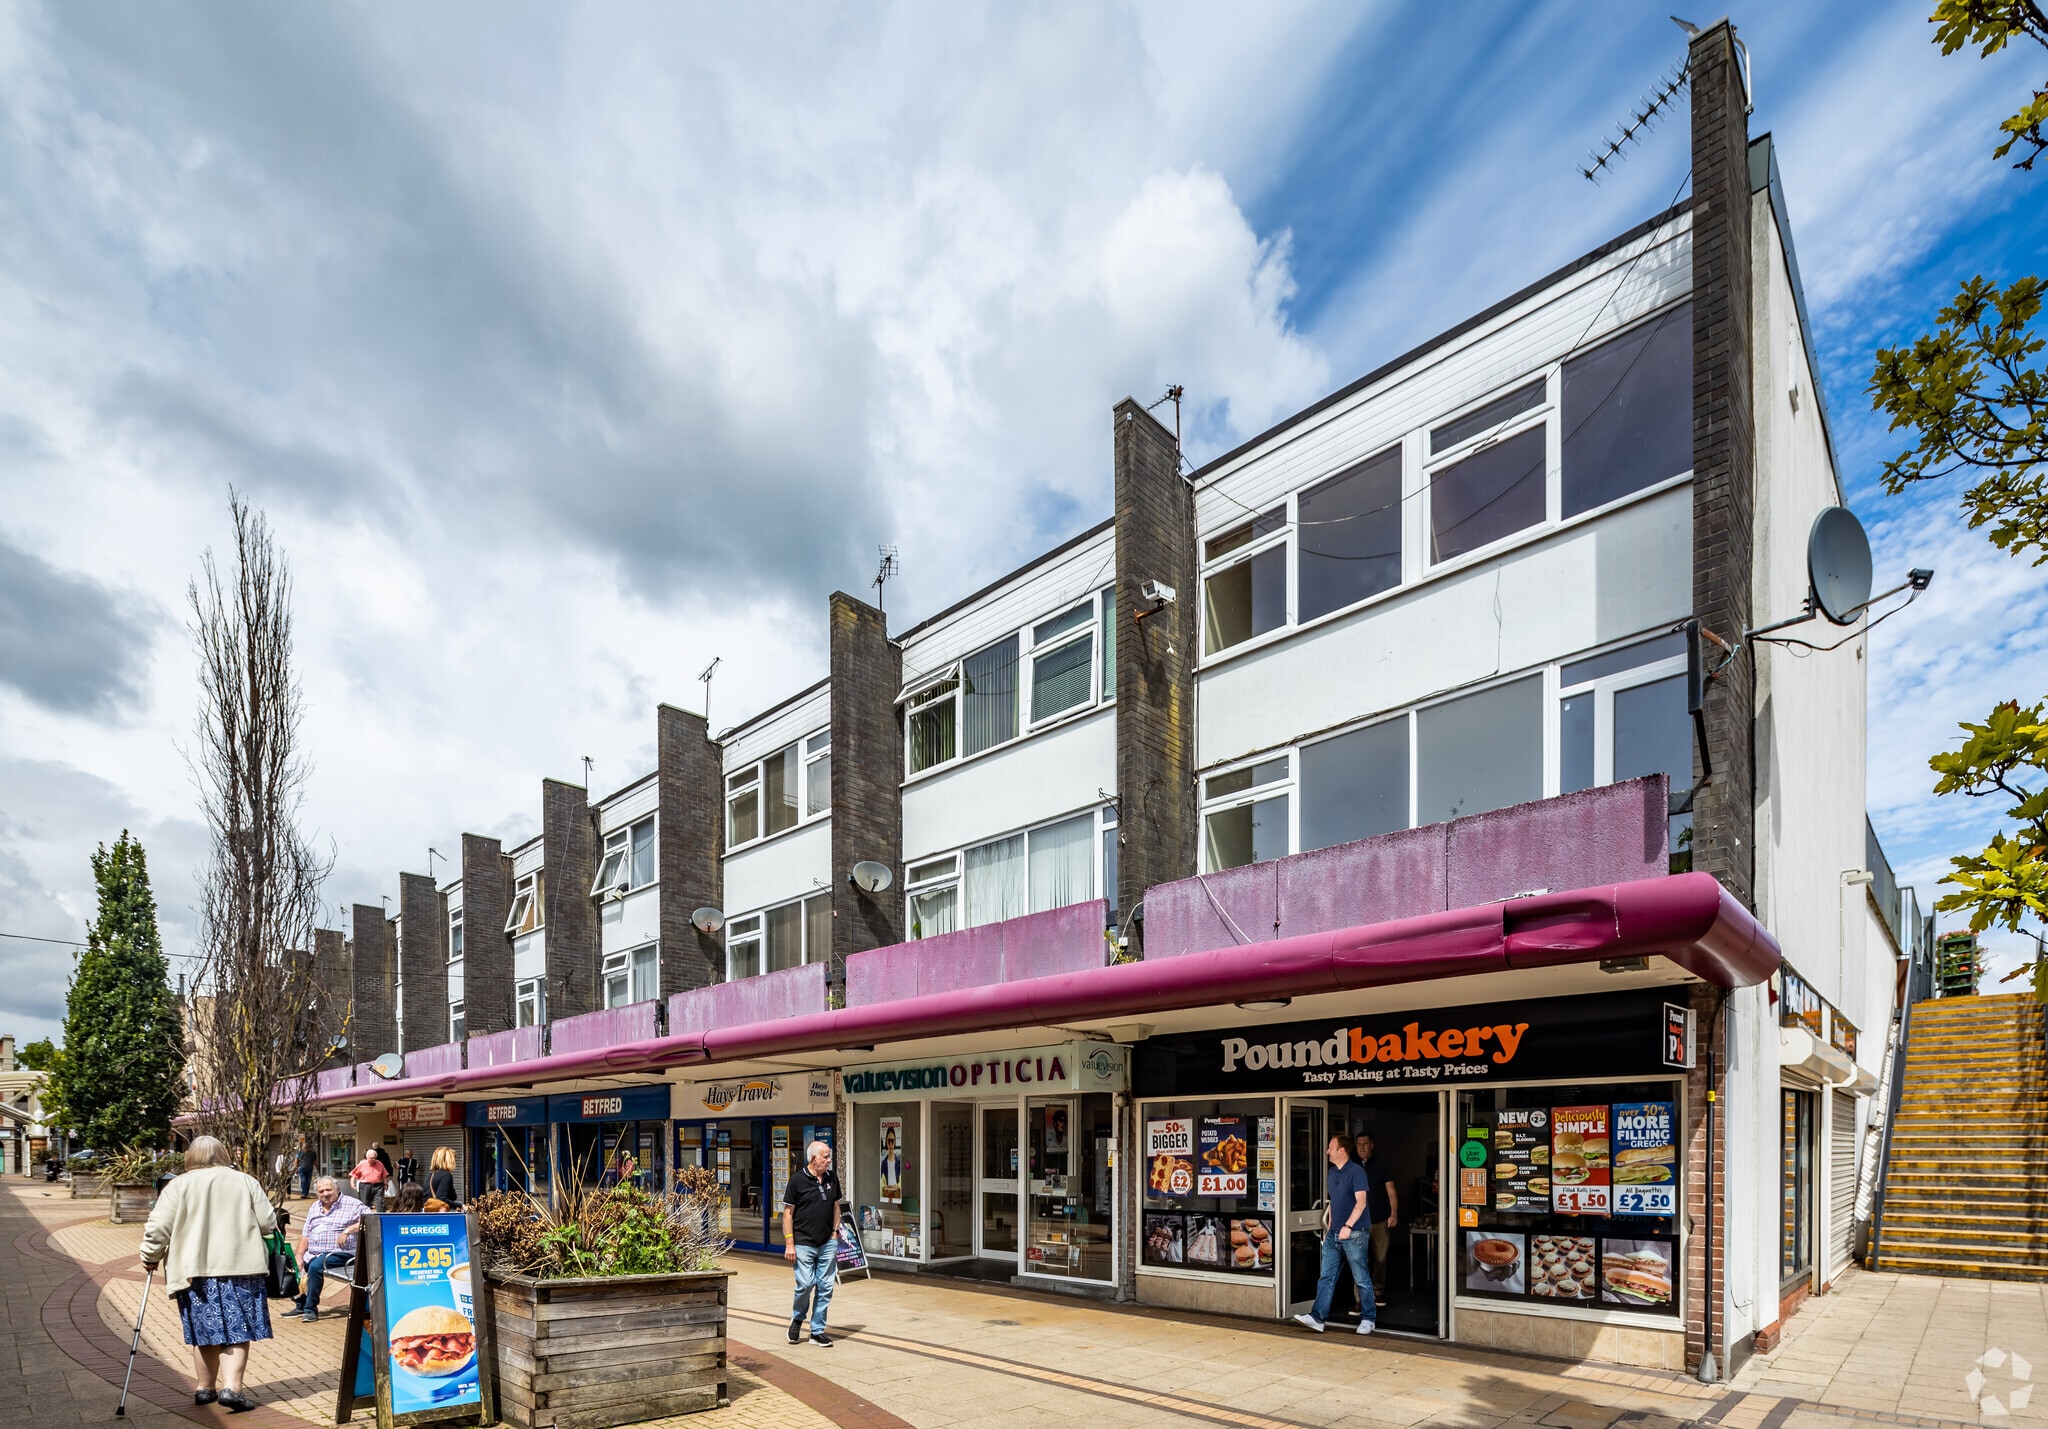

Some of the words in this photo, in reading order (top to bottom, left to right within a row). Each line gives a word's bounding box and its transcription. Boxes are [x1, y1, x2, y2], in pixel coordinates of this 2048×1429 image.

[1221, 1022, 1529, 1073] Poundbakery
[1082, 1060, 1124, 1072] valuevision
[1302, 1071, 1336, 1084] Tasty
[1338, 1069, 1384, 1082] Baking
[1386, 1068, 1401, 1079] at
[1403, 1065, 1441, 1080] Tasty
[1444, 1063, 1489, 1076] Prices
[812, 1082, 828, 1091] Hays
[843, 1066, 948, 1094] valuevision
[706, 1086, 734, 1106] Hays
[736, 1081, 774, 1102] Travel
[488, 1105, 517, 1120] BETFRED
[583, 1097, 622, 1115] BETFRED
[1619, 1109, 1640, 1117] over
[1642, 1104, 1668, 1119] 30%
[1498, 1111, 1529, 1124] NEW
[1554, 1108, 1606, 1125] Deliciously
[1618, 1115, 1670, 1130] MORE
[1165, 1122, 1186, 1134] 50%
[1555, 1121, 1606, 1134] SIMPLE
[1617, 1129, 1670, 1140] FILLING
[1152, 1133, 1189, 1150] BIGGER
[1631, 1140, 1668, 1148] GREGGS
[1173, 1176, 1188, 1187] £2
[1202, 1177, 1246, 1192] £1.00
[1557, 1192, 1607, 1211] £1.50
[1619, 1193, 1671, 1212] £2.50
[410, 1226, 448, 1235] GREGGS
[400, 1247, 453, 1270] £2.95
